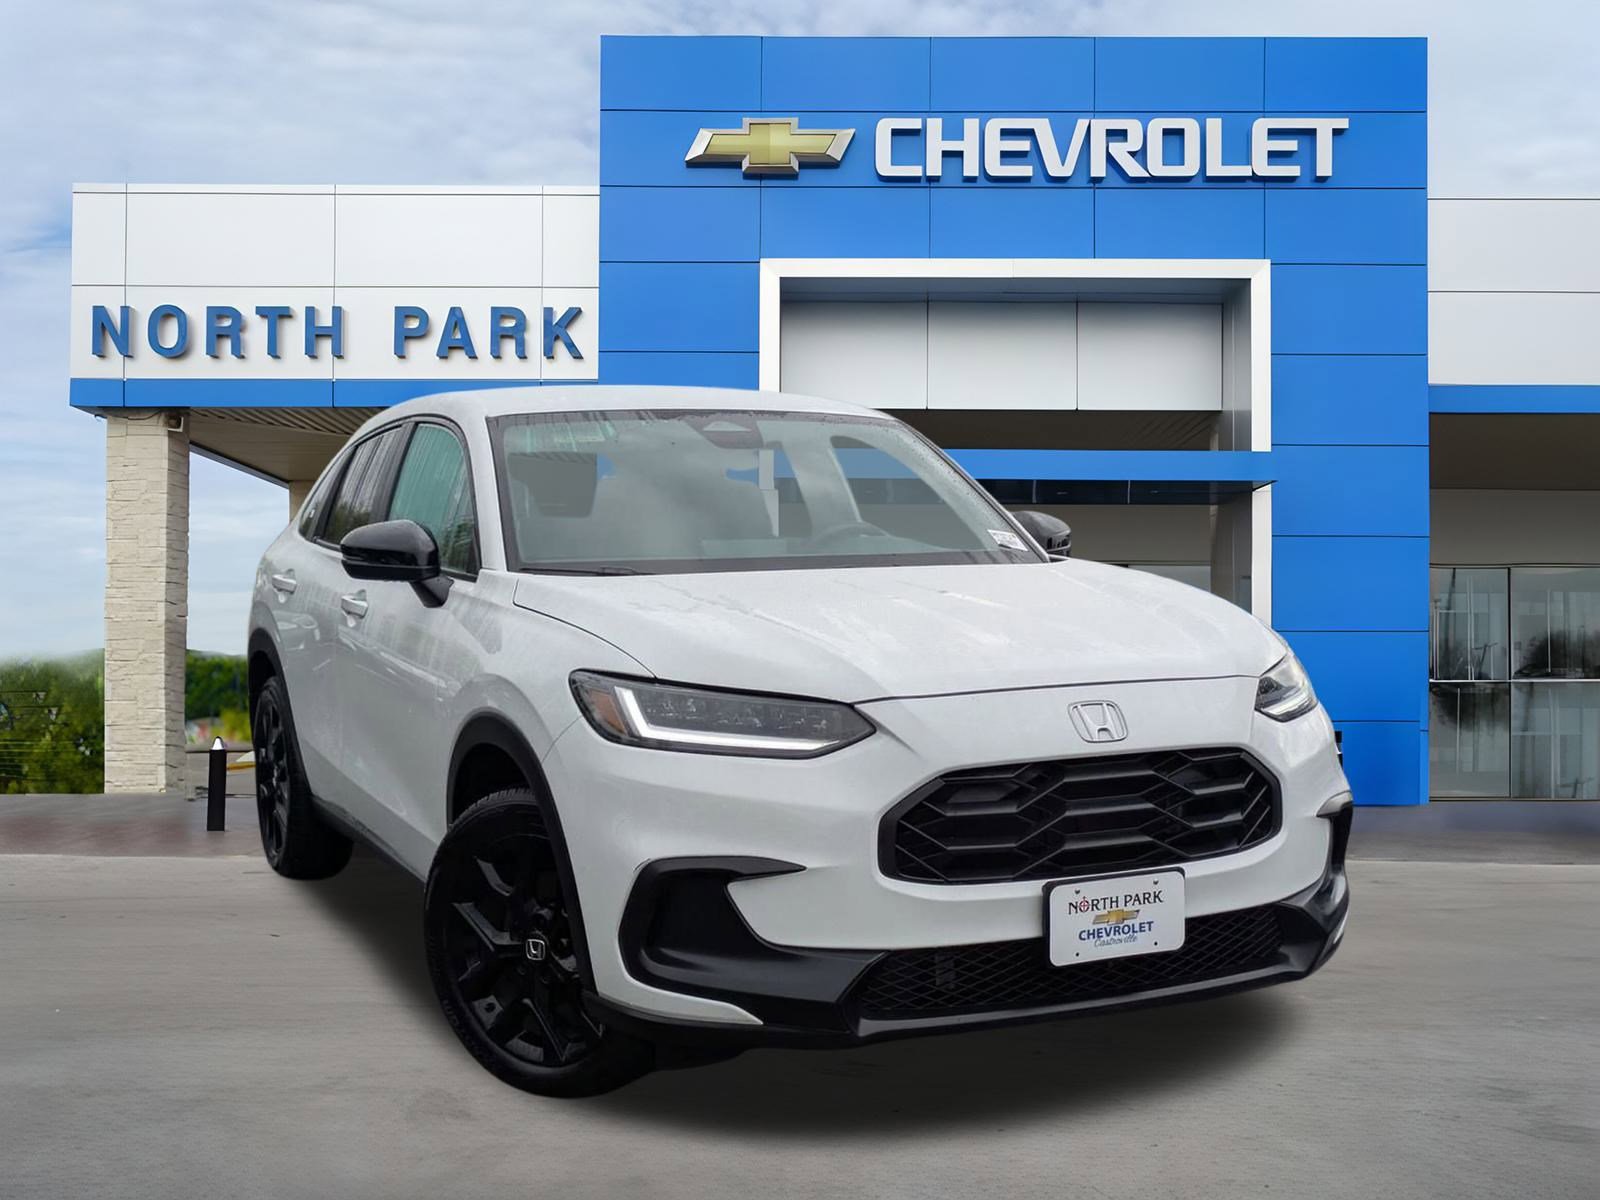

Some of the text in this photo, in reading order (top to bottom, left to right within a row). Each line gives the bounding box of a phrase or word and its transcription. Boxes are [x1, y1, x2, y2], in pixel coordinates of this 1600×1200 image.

[875, 117, 1350, 178] CHEVROLET
[91, 304, 585, 361] NORTH PARK
[1068, 890, 1163, 915] NORTH PARK
[1078, 921, 1154, 941] CHEVROLET
